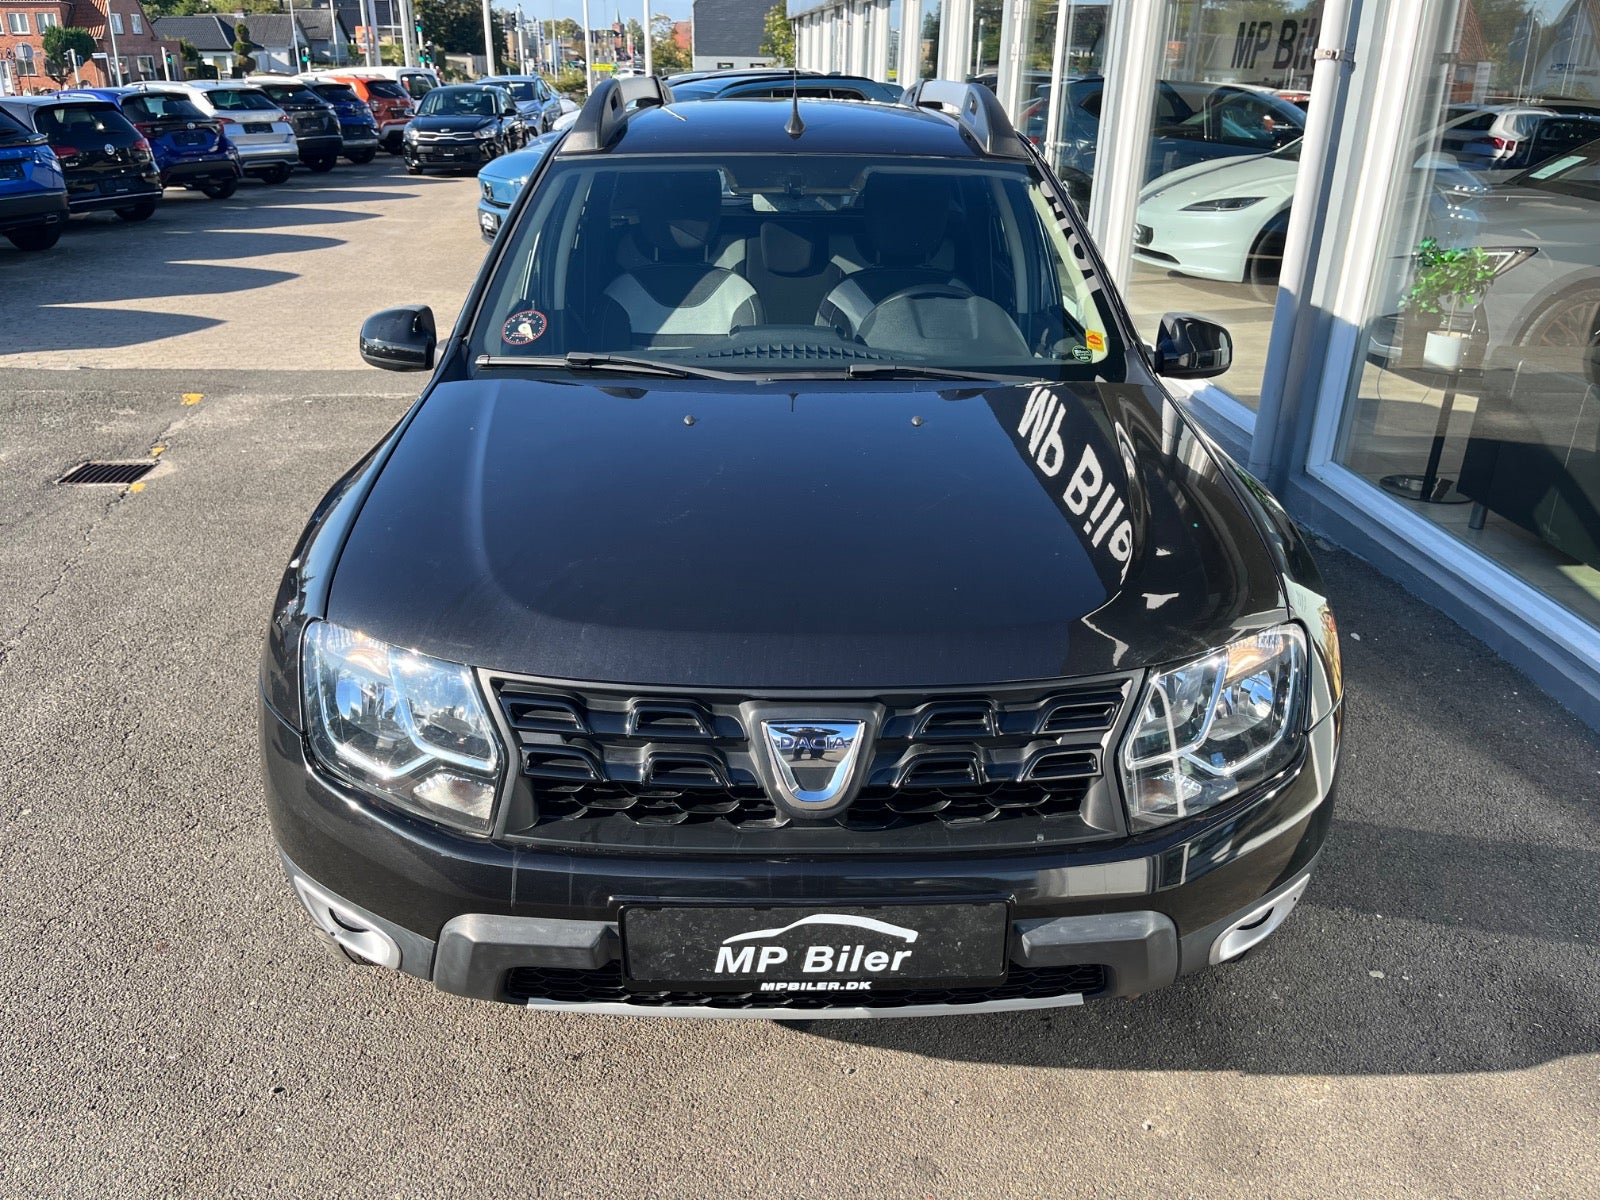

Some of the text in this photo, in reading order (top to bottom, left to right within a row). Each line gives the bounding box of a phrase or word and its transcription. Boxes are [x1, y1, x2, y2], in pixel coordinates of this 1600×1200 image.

[1230, 21, 1273, 69] MP
[780, 736, 848, 750] DACIA
[714, 944, 913, 974] MP Biler
[760, 981, 873, 992] MPBILER.DK
